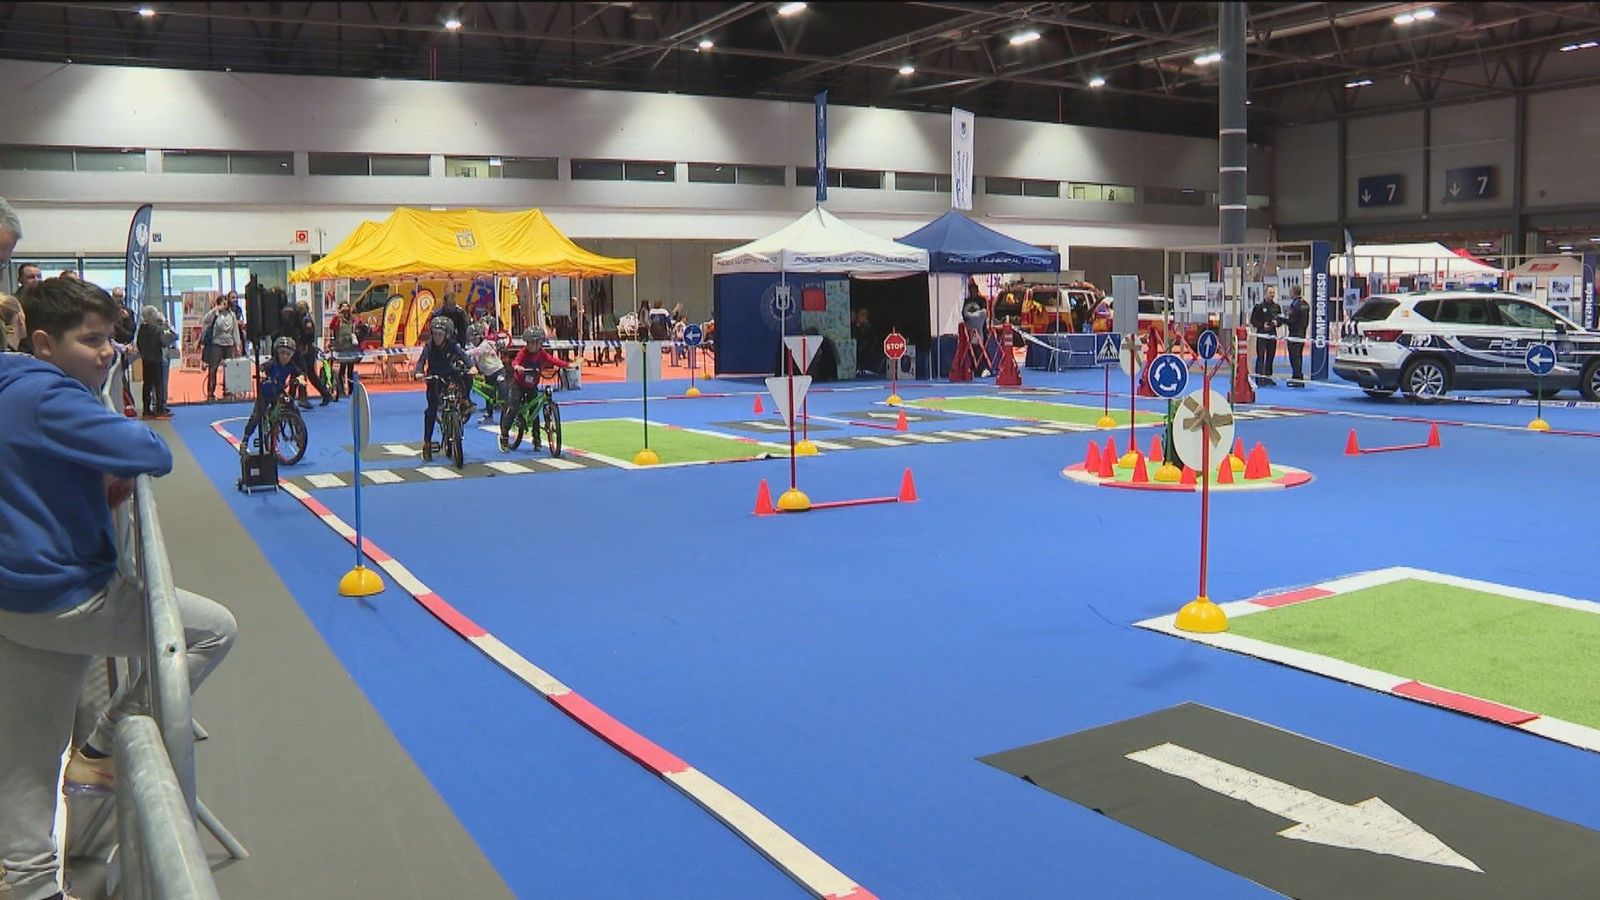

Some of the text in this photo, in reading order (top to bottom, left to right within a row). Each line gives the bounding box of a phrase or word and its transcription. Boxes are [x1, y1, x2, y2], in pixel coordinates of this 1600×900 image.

[1387, 183, 1397, 201] 7
[1477, 176, 1488, 195] 7
[1316, 273, 1326, 348] COMPROMISO
[886, 343, 904, 351] STOP
